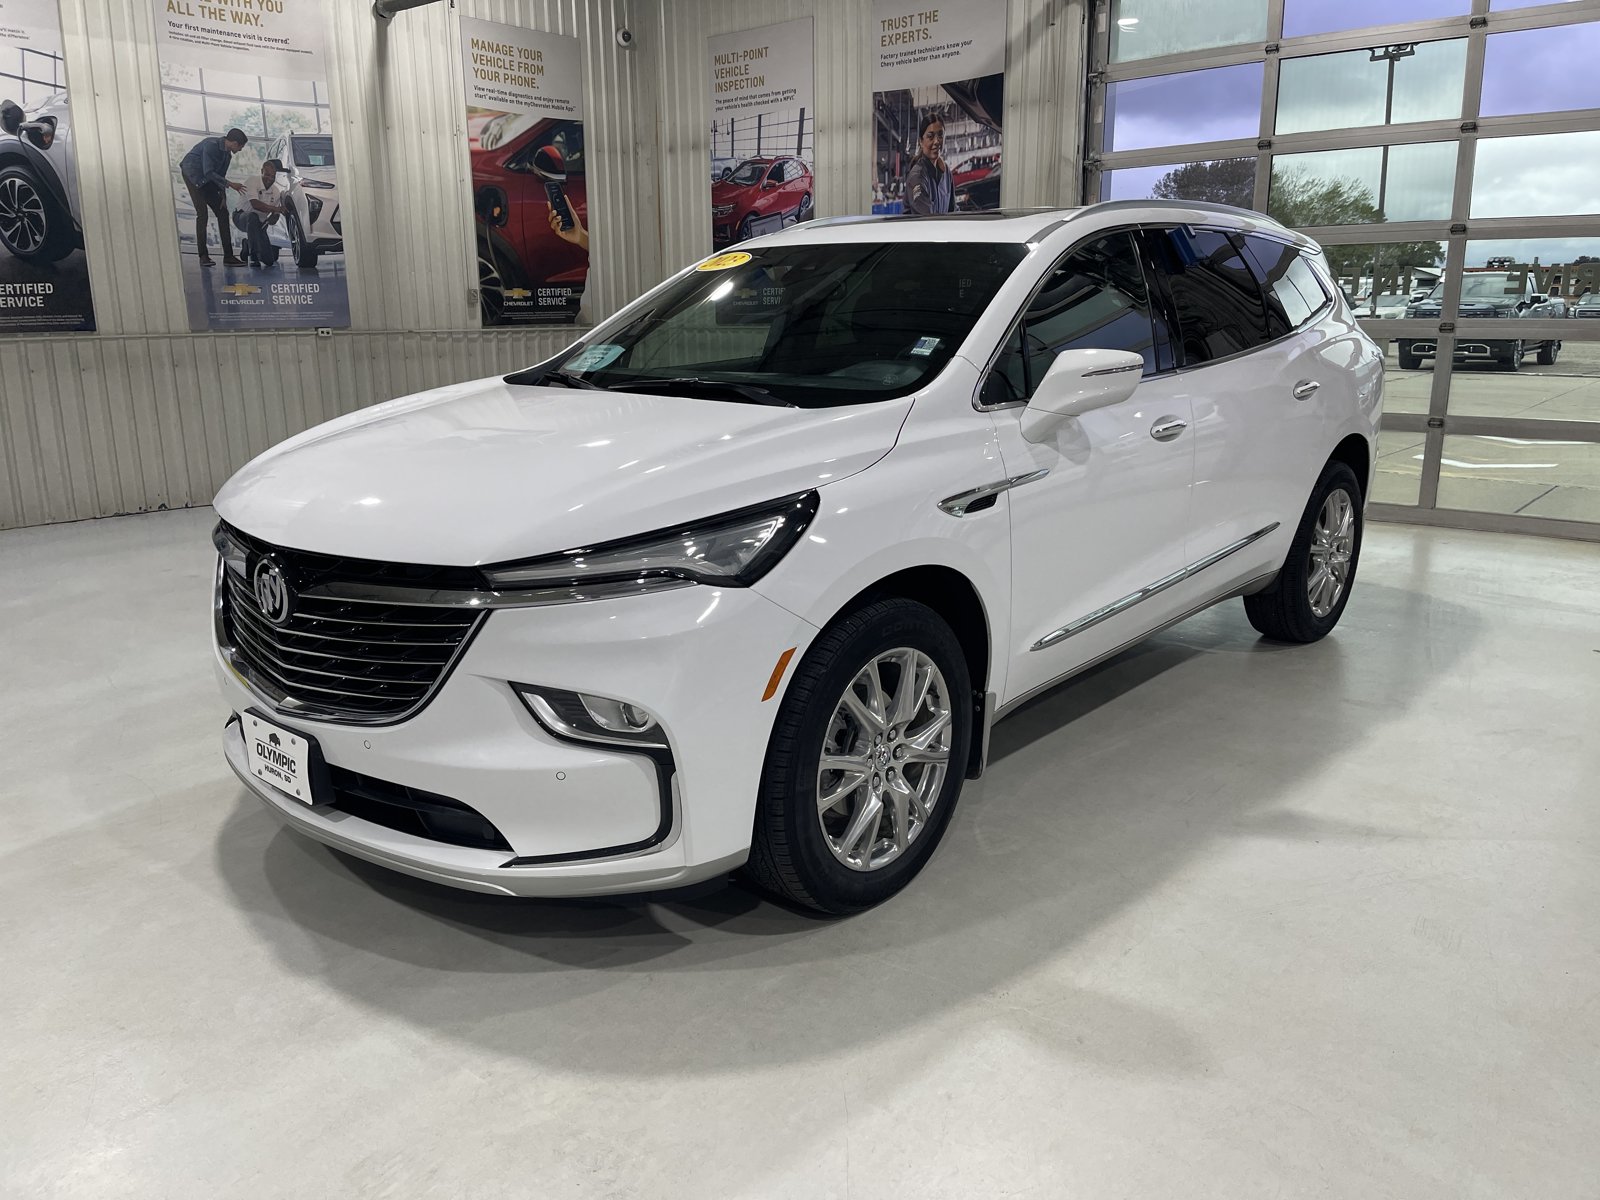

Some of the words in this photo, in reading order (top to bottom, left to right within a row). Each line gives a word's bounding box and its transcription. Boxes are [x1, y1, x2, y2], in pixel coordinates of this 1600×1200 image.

[167, 1, 195, 17] ALL
[198, 5, 227, 21] THE
[230, 10, 264, 27] WAY.
[257, 0, 283, 13] YOU
[168, 20, 183, 29] Your
[184, 23, 199, 32] first
[201, 26, 241, 38] maintenance
[880, 14, 914, 32] TRUST
[917, 10, 939, 25] THE
[880, 28, 932, 47] EXPERTS.
[471, 38, 514, 57] MANAGE
[517, 47, 543, 62] YOUR
[714, 46, 769, 66] MULTI-POINT
[899, 49, 917, 57] trained
[917, 45, 945, 55] technicians
[960, 40, 973, 48] your
[471, 52, 515, 71] VEHICLE
[517, 62, 544, 76] FROM
[880, 60, 895, 68] Chevy
[895, 57, 912, 66] vehicle
[913, 55, 928, 63] better
[941, 50, 961, 59] anyone.
[473, 67, 500, 82] YOUR
[503, 72, 540, 89] PHONE.
[714, 64, 750, 79] VEHICLE
[715, 75, 765, 93] INSPECTION
[486, 87, 507, 96] real-time
[508, 90, 533, 100] diagnostics
[271, 283, 320, 294] CERTIFIED
[537, 288, 572, 297] CERTIFIED
[272, 294, 313, 305] SERVICE
[538, 297, 566, 306] SERVICE
[256, 742, 296, 774] OLYMPIC
[264, 764, 283, 780] HURON,
